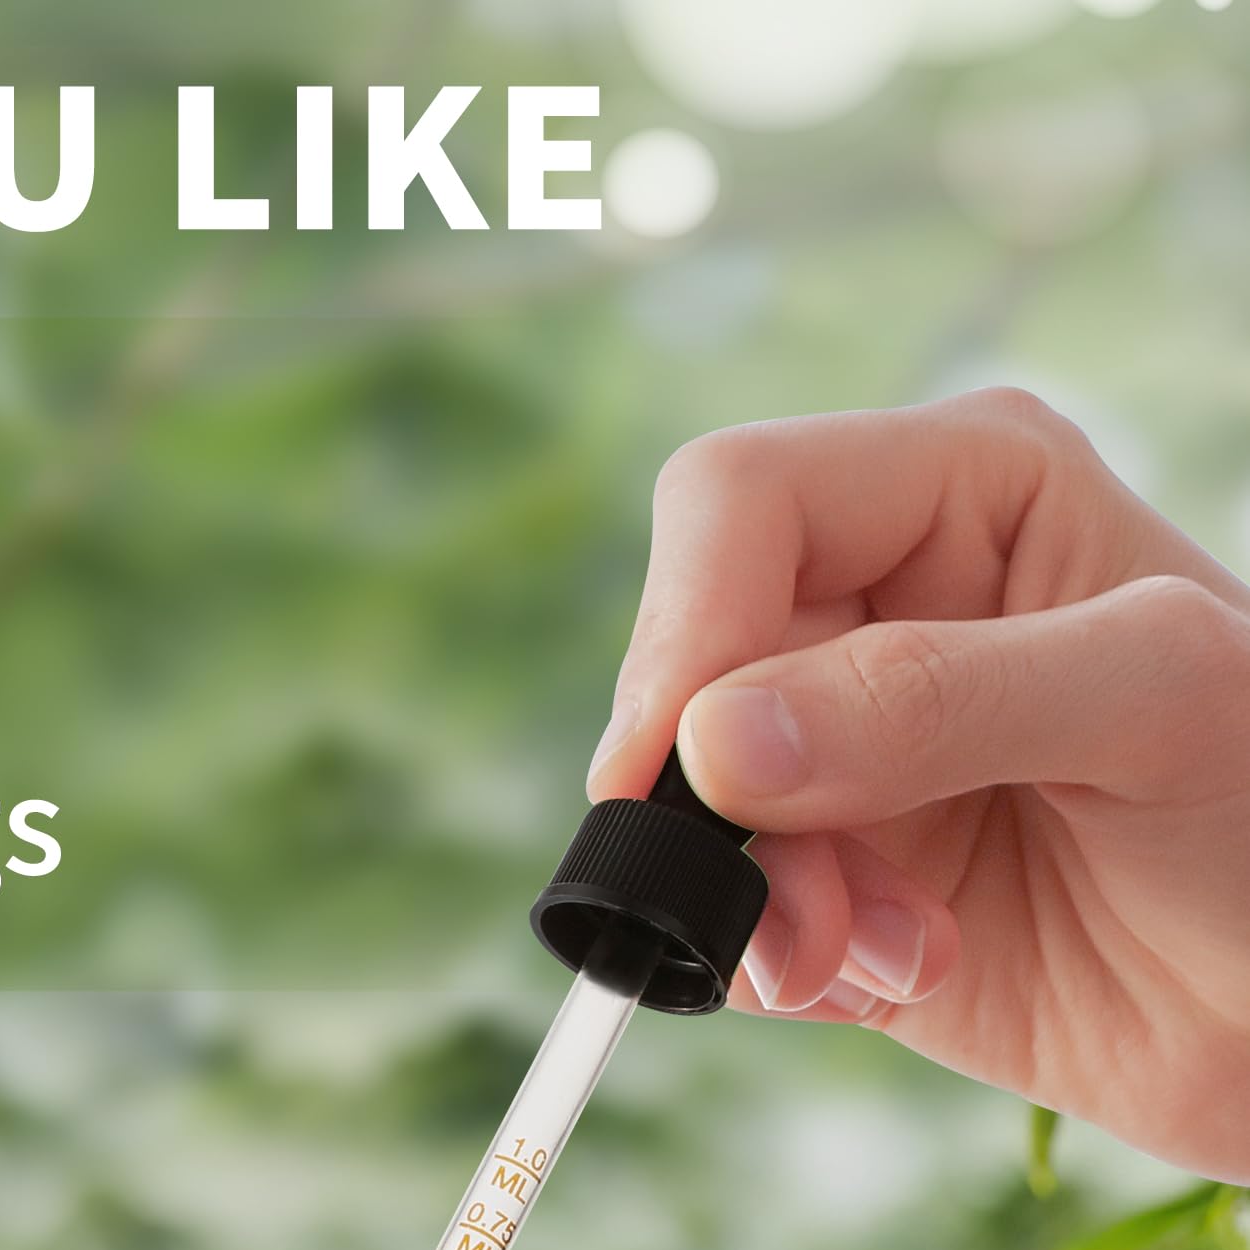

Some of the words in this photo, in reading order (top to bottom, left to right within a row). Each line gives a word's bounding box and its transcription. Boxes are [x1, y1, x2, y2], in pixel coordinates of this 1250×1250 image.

[512, 1138, 547, 1172] 1.0
[491, 1166, 527, 1205] ML
[466, 1202, 517, 1245] 0.75
